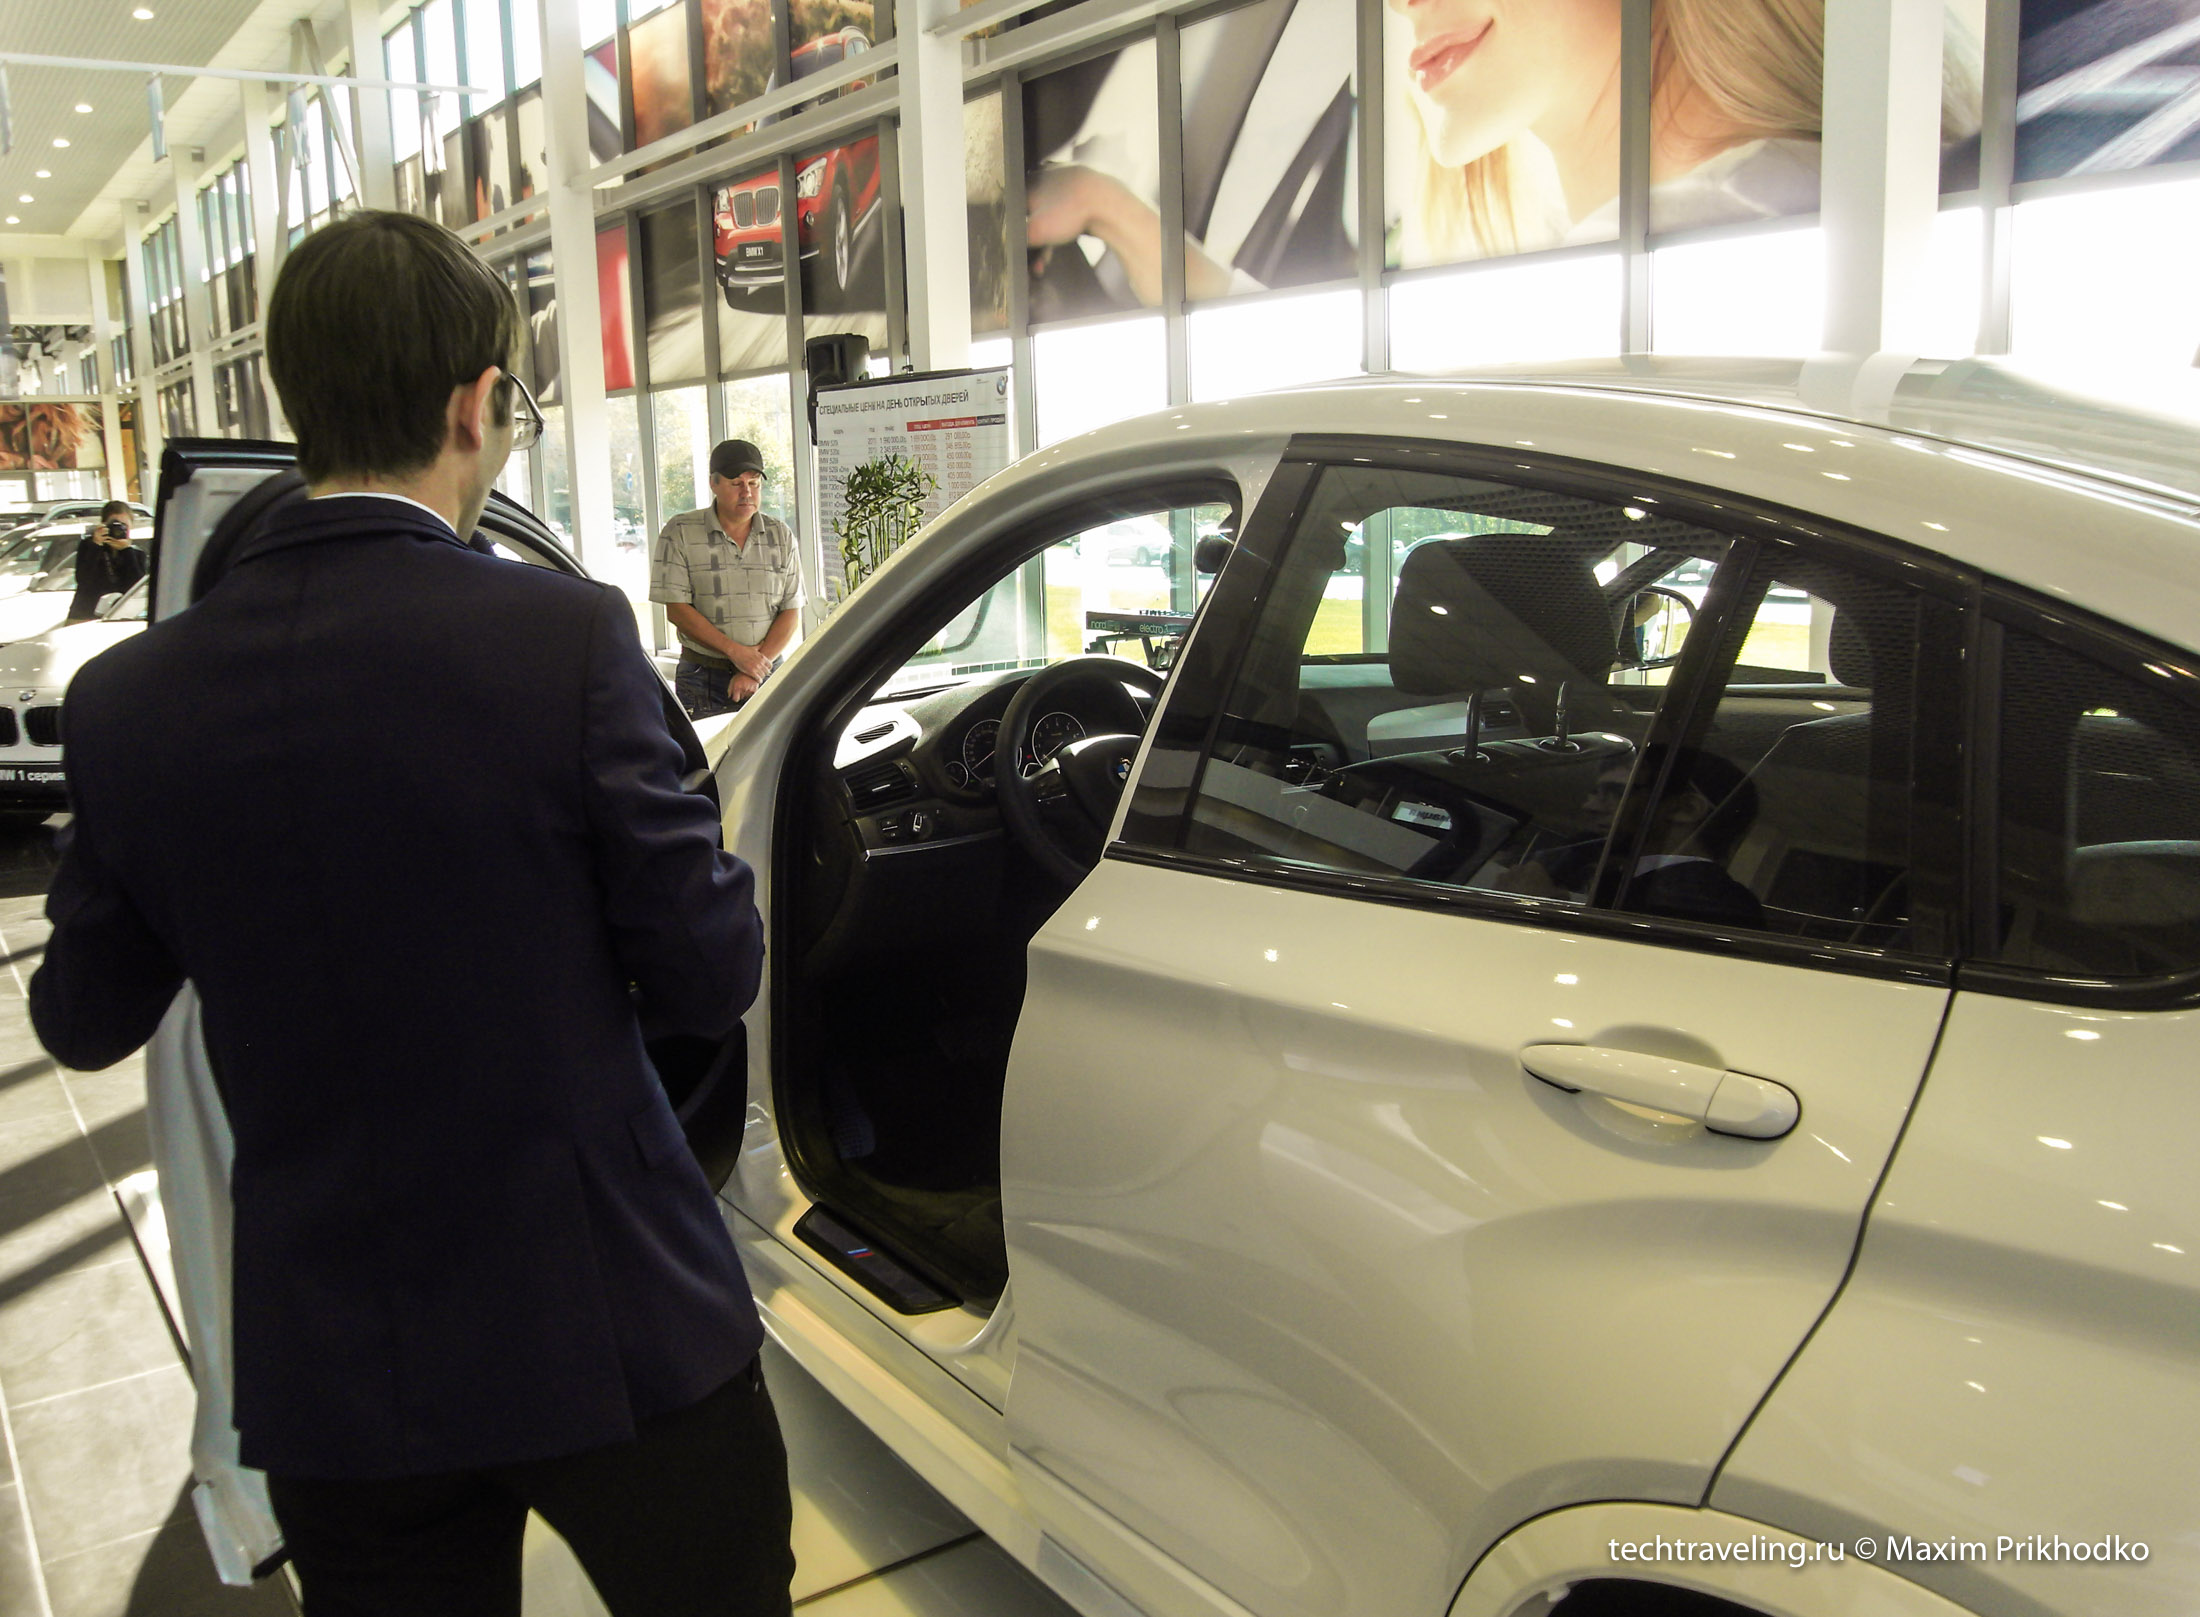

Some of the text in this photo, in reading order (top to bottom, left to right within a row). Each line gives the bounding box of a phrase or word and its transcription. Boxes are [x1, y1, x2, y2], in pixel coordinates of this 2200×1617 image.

[746, 247, 757, 257] BMW
[819, 389, 969, 415] СПЕЦИАЛЬНЫЕ ЦЕНЫ НА ДЕНЬ ОТКРЫТЫХ ДВЕРЕЙ
[1090, 620, 1107, 629] nord
[1139, 623, 1163, 634] electro
[17, 769, 25, 781] 1
[27, 772, 66, 784] серия
